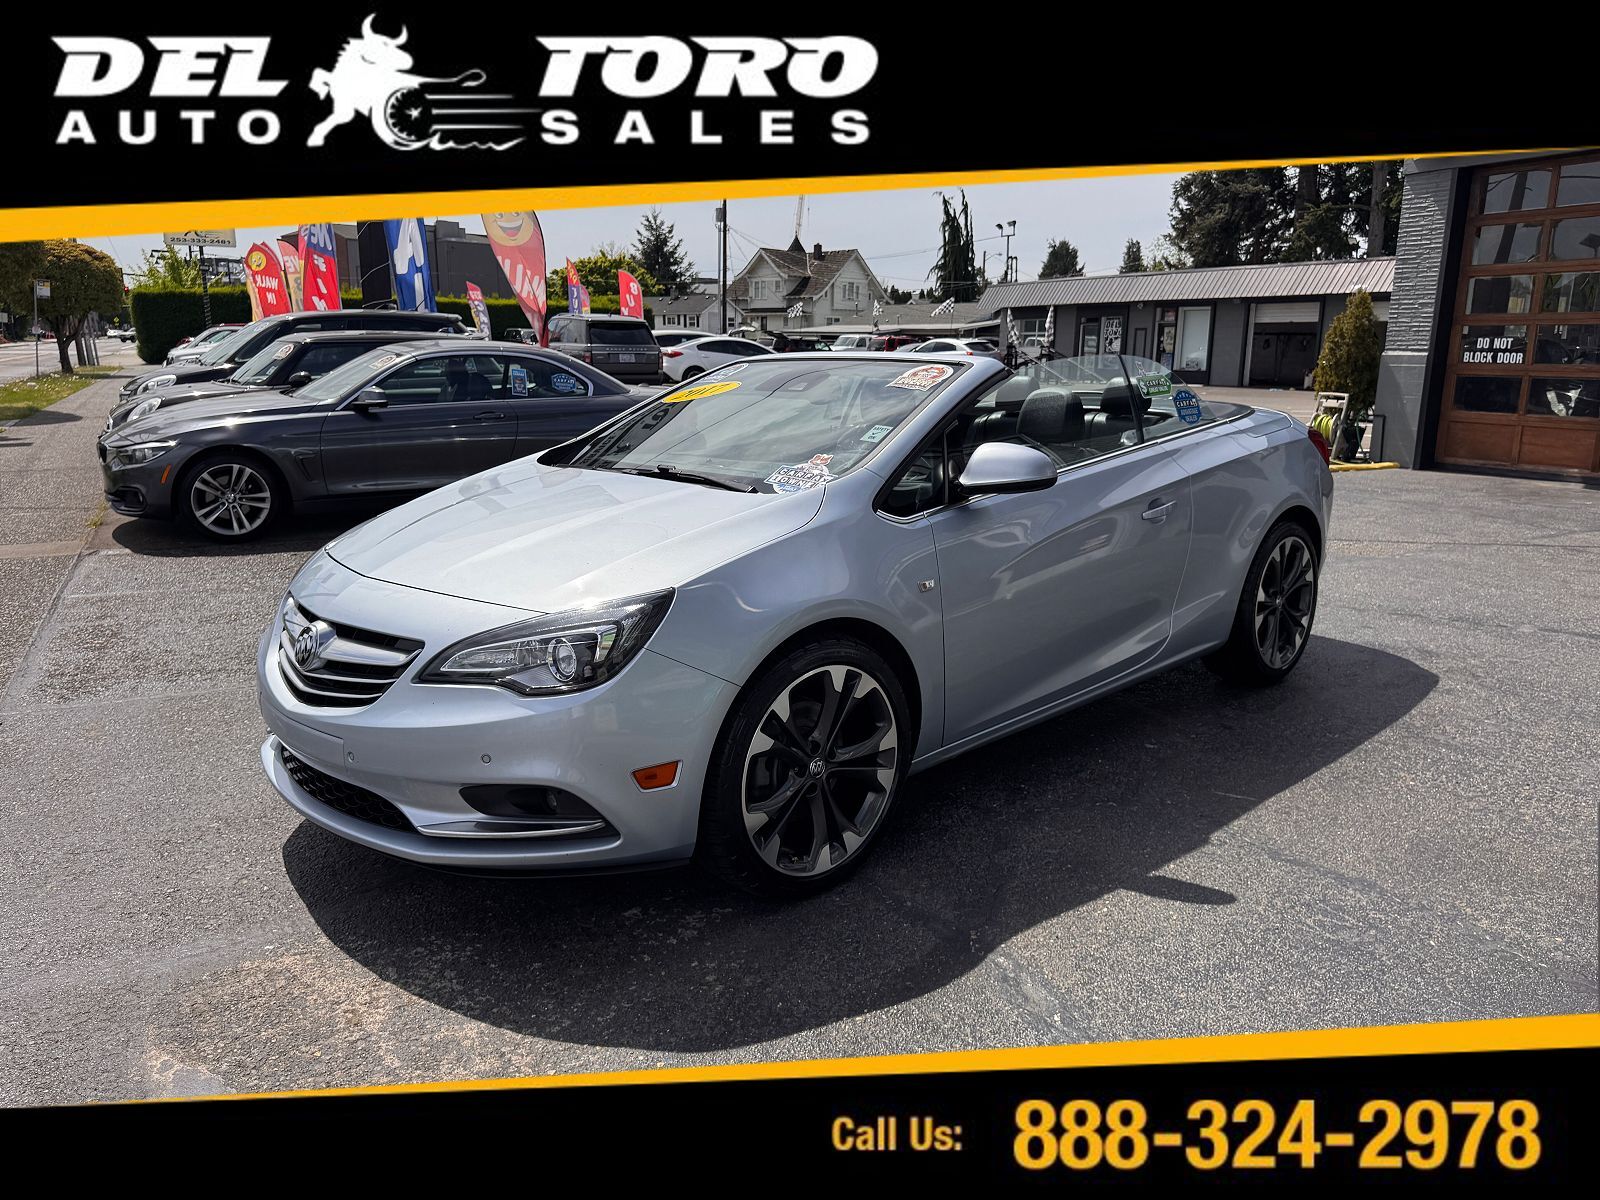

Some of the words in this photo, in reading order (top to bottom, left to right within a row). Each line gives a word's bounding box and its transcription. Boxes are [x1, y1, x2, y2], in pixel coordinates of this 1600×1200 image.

[1476, 337, 1490, 349] DO
[1493, 337, 1514, 350] NOT
[1463, 351, 1494, 363] BLOCK
[1496, 352, 1524, 364] DOOR
